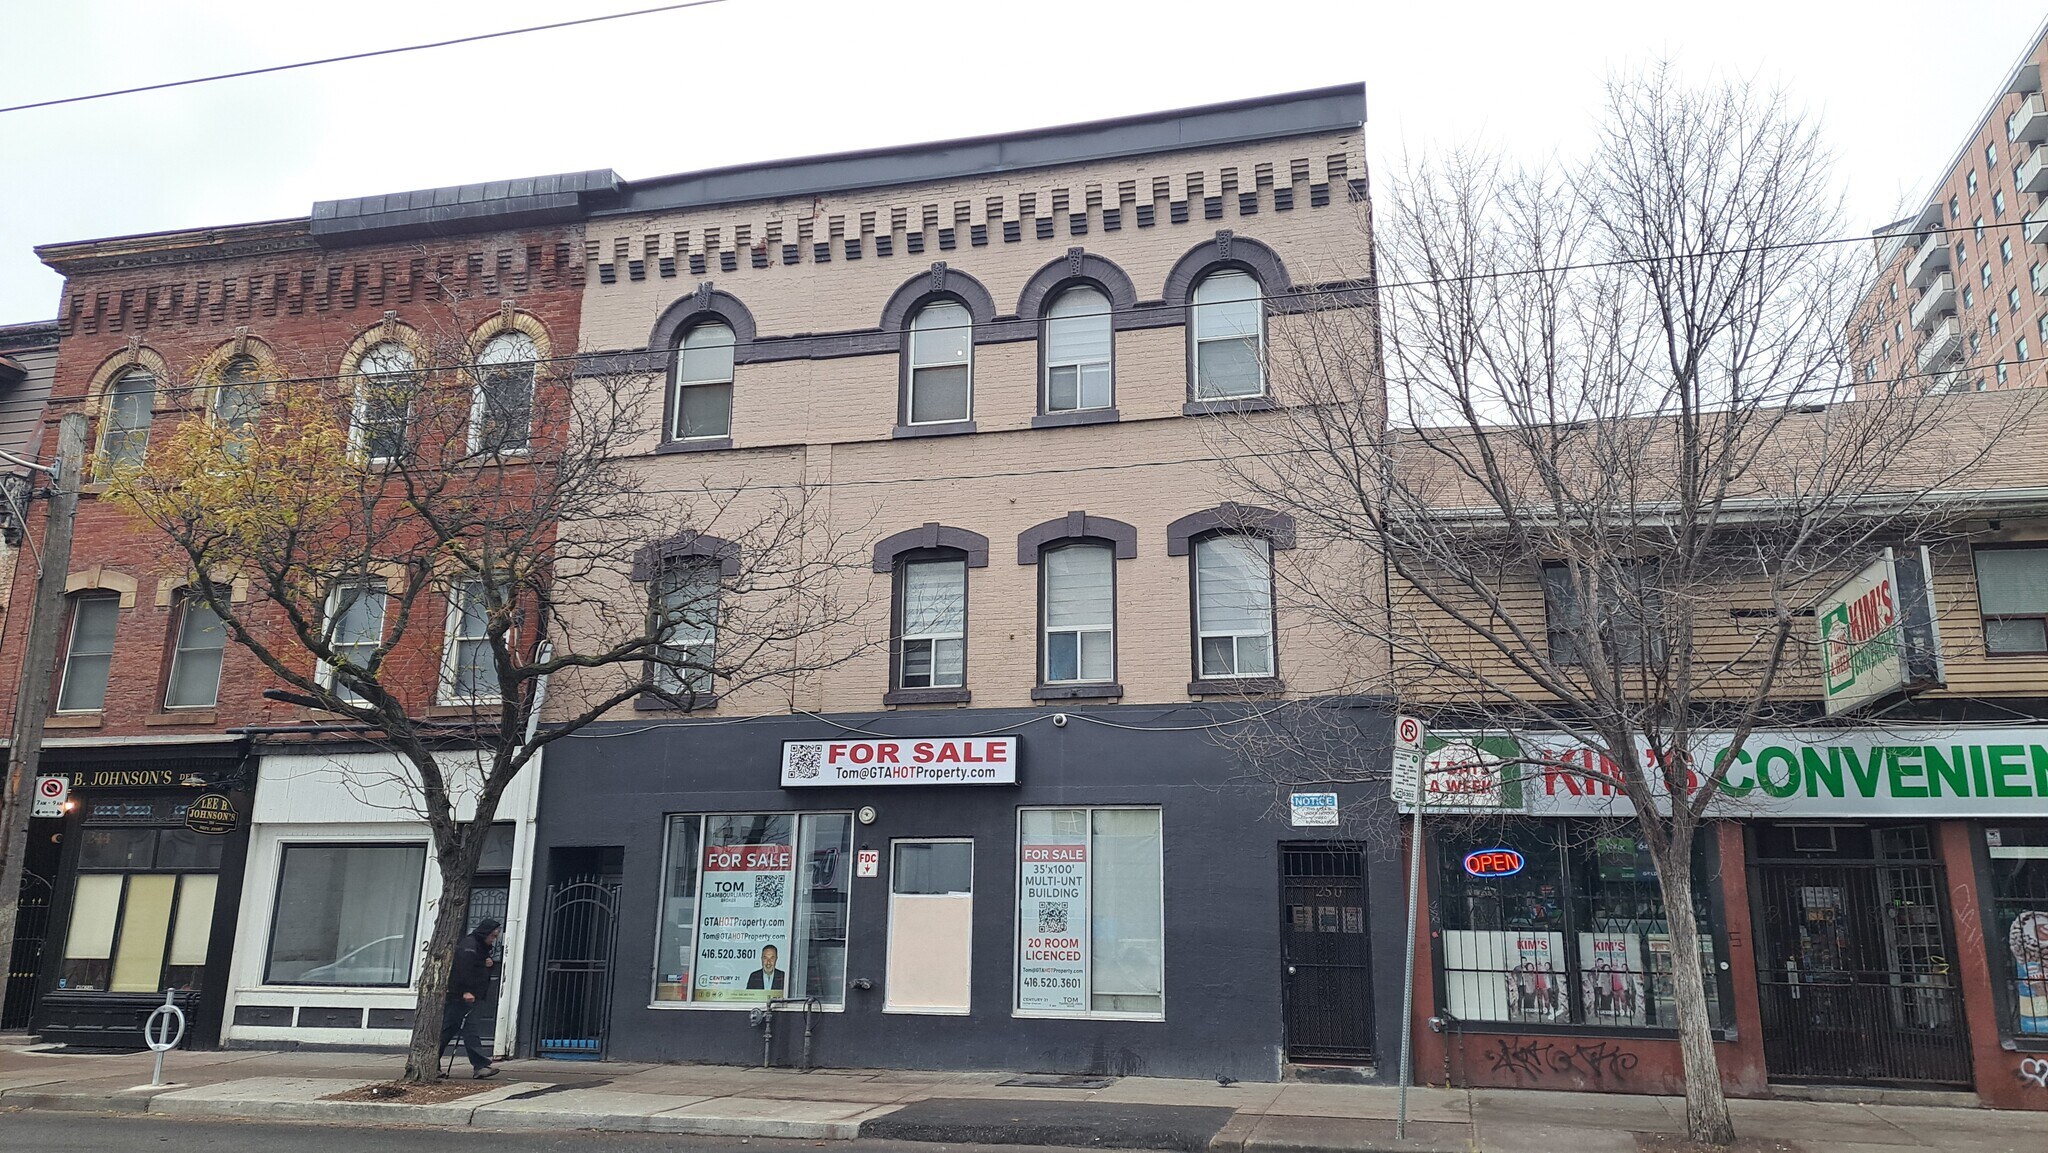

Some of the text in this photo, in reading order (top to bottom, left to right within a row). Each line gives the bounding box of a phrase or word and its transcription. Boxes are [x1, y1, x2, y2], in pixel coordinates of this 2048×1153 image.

[1848, 580, 1893, 642] KIM'S
[829, 742, 1007, 764] FOR SALE
[73, 772, 87, 786] B.
[91, 770, 172, 786] JOHNSON'S
[836, 766, 996, 781] Tom@GTAHOTProperty.com
[1430, 780, 1440, 792] A
[201, 797, 219, 810] LEE
[1295, 796, 1334, 806] NOTICE
[188, 809, 236, 822] JOHNSON'S
[709, 853, 789, 867] FOR SALE
[859, 853, 877, 863] FDC
[1025, 849, 1083, 860] FOR SALE
[1033, 864, 1075, 874] 35'x100'
[1467, 853, 1519, 874] OPEN
[714, 881, 744, 892] TOM
[1025, 876, 1083, 886] MULTI-UNT
[1028, 888, 1079, 898] BUILDING
[703, 917, 785, 929] GTAHOTProperty.com
[702, 932, 786, 942] Tom@GTAHOTProperty.com
[1028, 938, 1079, 949] 20 ROOM
[1516, 940, 1548, 950] KIM'S
[1594, 941, 1626, 952] KIM'S
[701, 949, 757, 960] 416.520.3601
[1025, 951, 1081, 961] LICENCED
[1023, 977, 1081, 989] 416.520.3601
